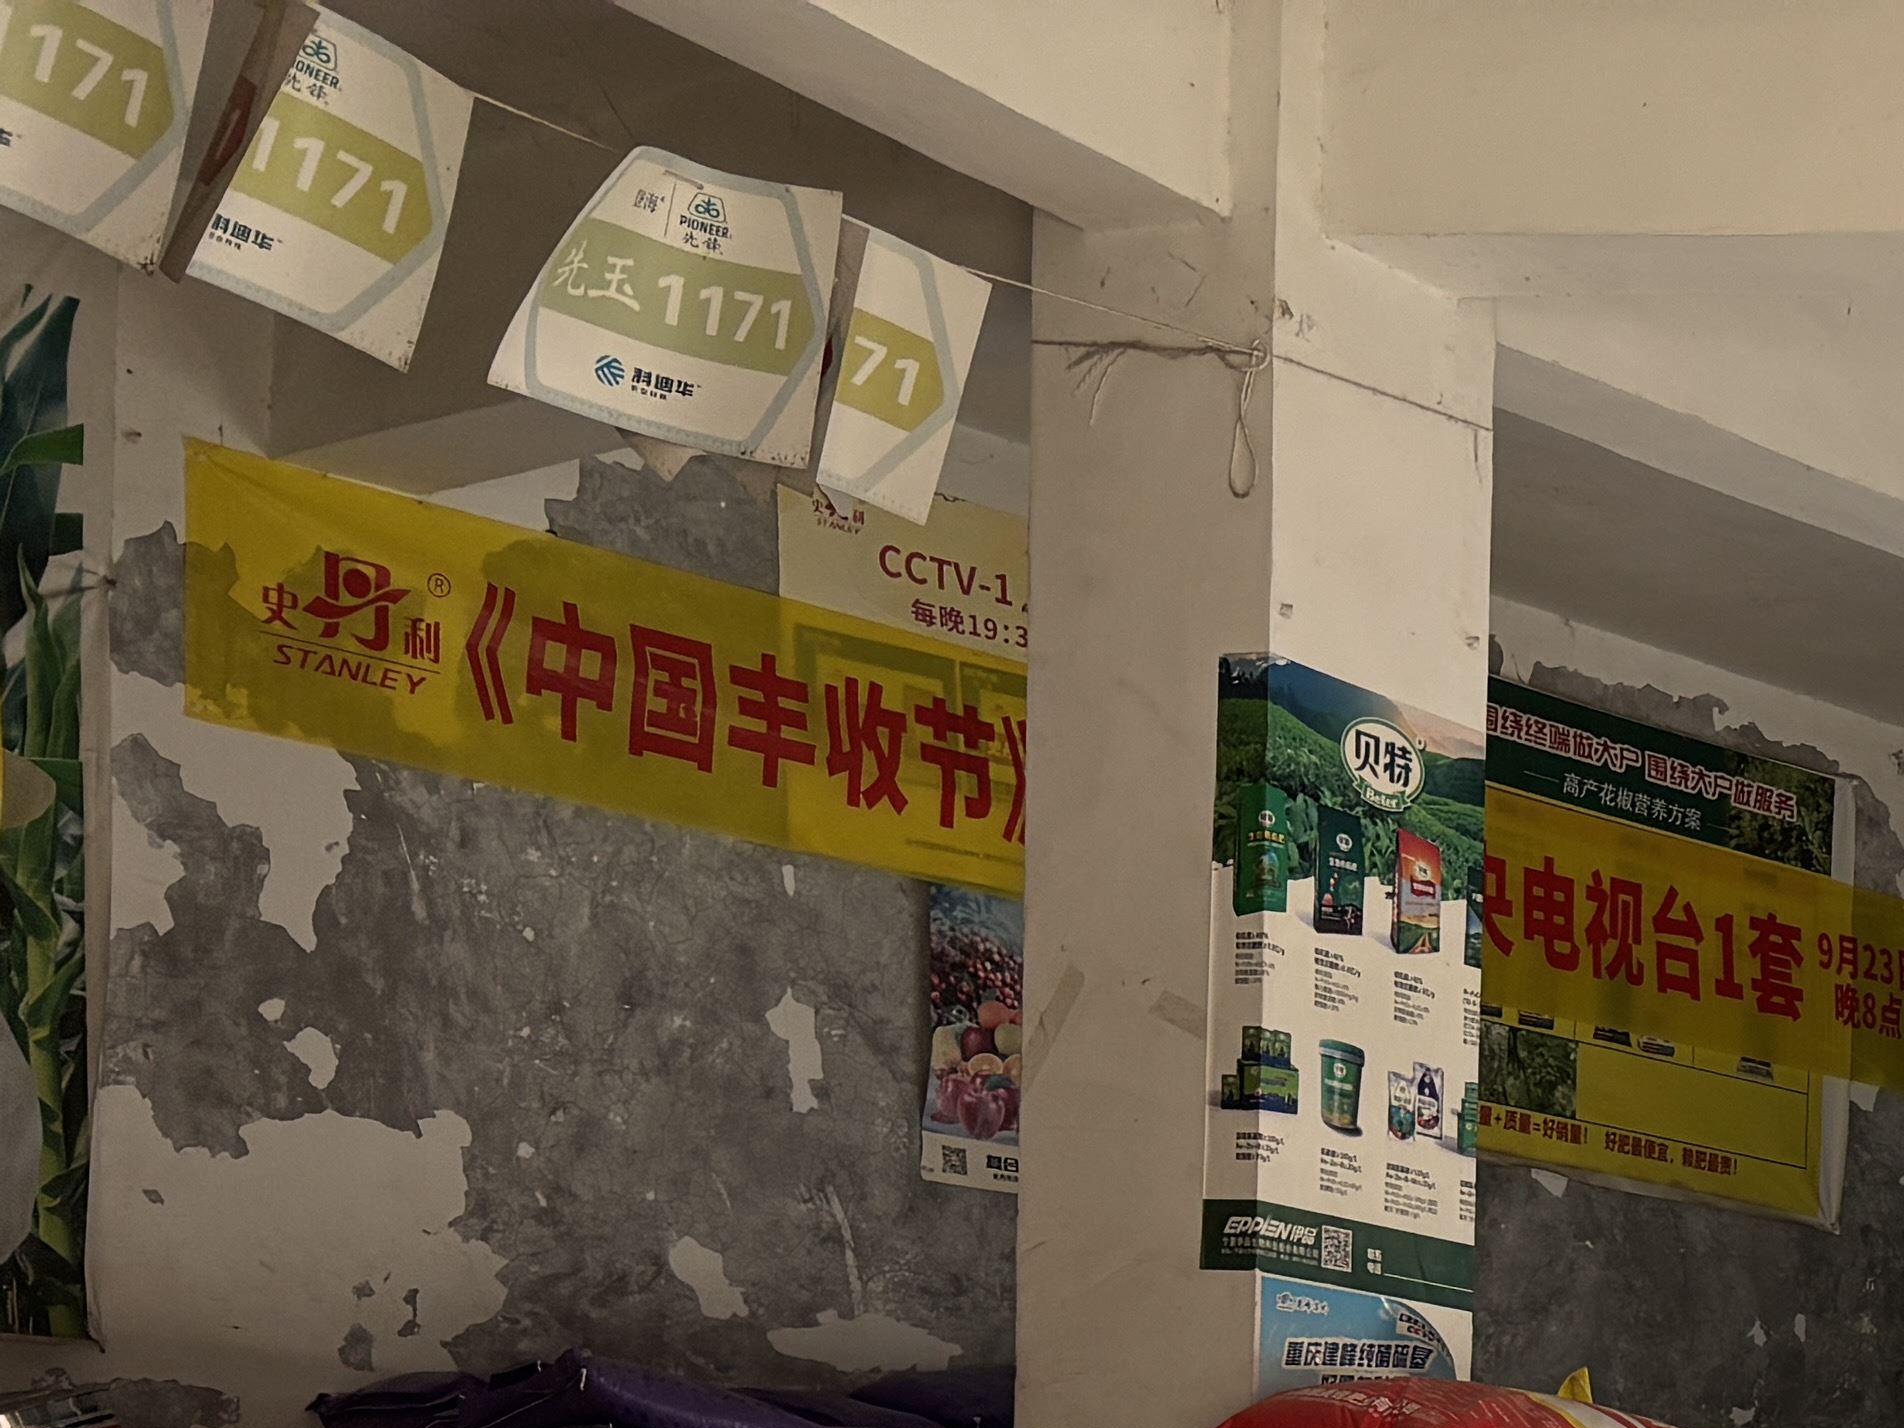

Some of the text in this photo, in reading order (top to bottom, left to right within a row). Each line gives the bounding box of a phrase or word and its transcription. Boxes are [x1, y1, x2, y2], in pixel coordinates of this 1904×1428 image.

[252, 116, 408, 235] 1171
[679, 214, 730, 240] PIONEER
[681, 231, 722, 254] 先锋
[552, 239, 792, 350] 先玉1171
[850, 335, 920, 406] 71
[261, 550, 441, 664] 史丹利
[272, 641, 428, 696] STANLEY
[1354, 729, 1413, 789] 贝特
[1645, 750, 1799, 823] 围绕大户做服务
[1563, 772, 1702, 832] 高产花椒营养方案
[1834, 983, 1903, 1041] 晚8点
